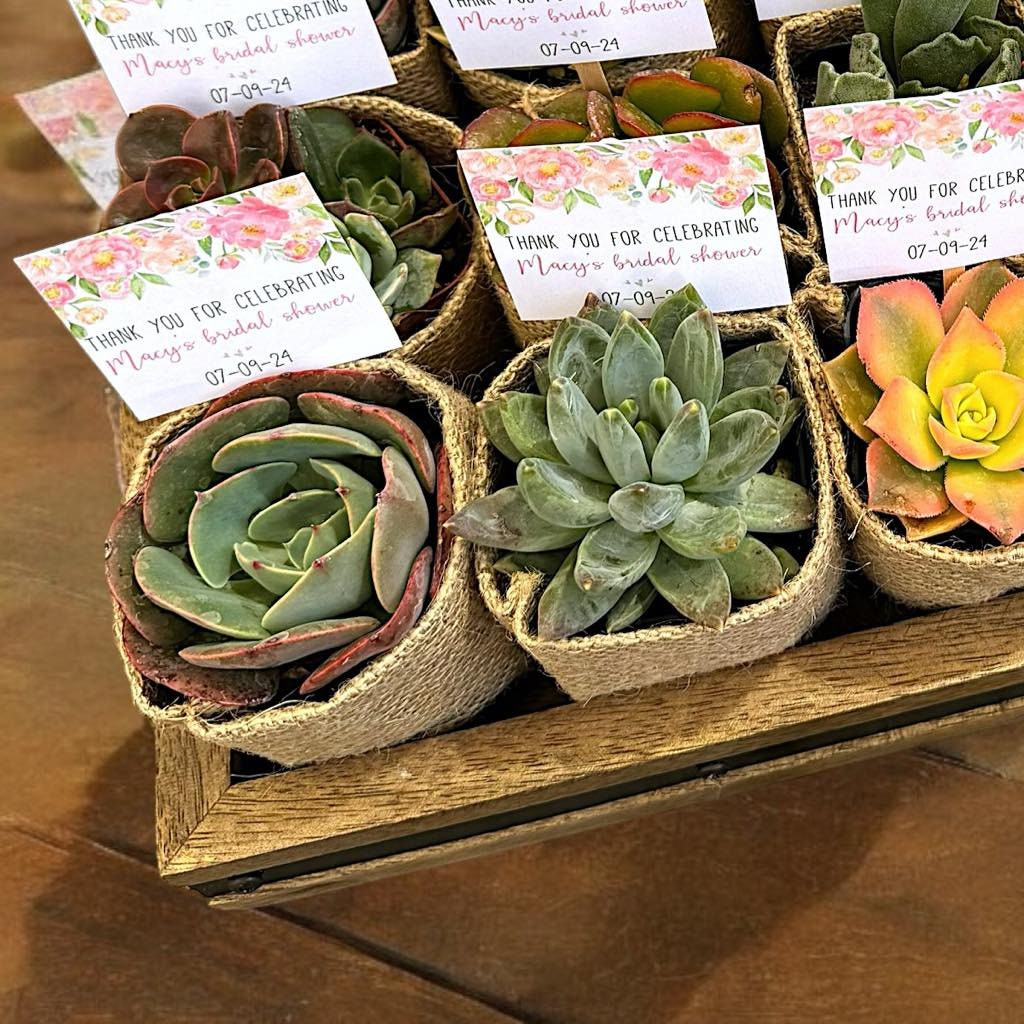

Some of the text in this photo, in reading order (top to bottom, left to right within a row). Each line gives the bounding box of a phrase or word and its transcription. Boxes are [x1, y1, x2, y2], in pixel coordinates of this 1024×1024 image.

[457, 7, 539, 32] Macy's
[547, 1, 612, 24] bridal
[107, 30, 160, 52] THANK
[164, 26, 198, 45] YOU
[204, 20, 238, 40] FOR
[123, 26, 357, 79] Macy's bridal shower
[539, 37, 620, 57] 07-09-24
[209, 76, 293, 104] 07-09-24
[827, 189, 878, 210] THANK
[888, 185, 918, 203] YOU
[928, 181, 958, 200] FOR
[833, 204, 917, 236] Macy's
[925, 195, 991, 223] bridal
[504, 218, 760, 251] THANK YOU FOR CELEBRATING
[907, 234, 988, 261] 07-09-24
[517, 244, 763, 278] Macy's bridal shower
[83, 264, 345, 352] THANK YOU FOR CELEBRATING
[104, 293, 355, 375] Macy's bridal shower
[204, 349, 294, 386] 07-09-24
